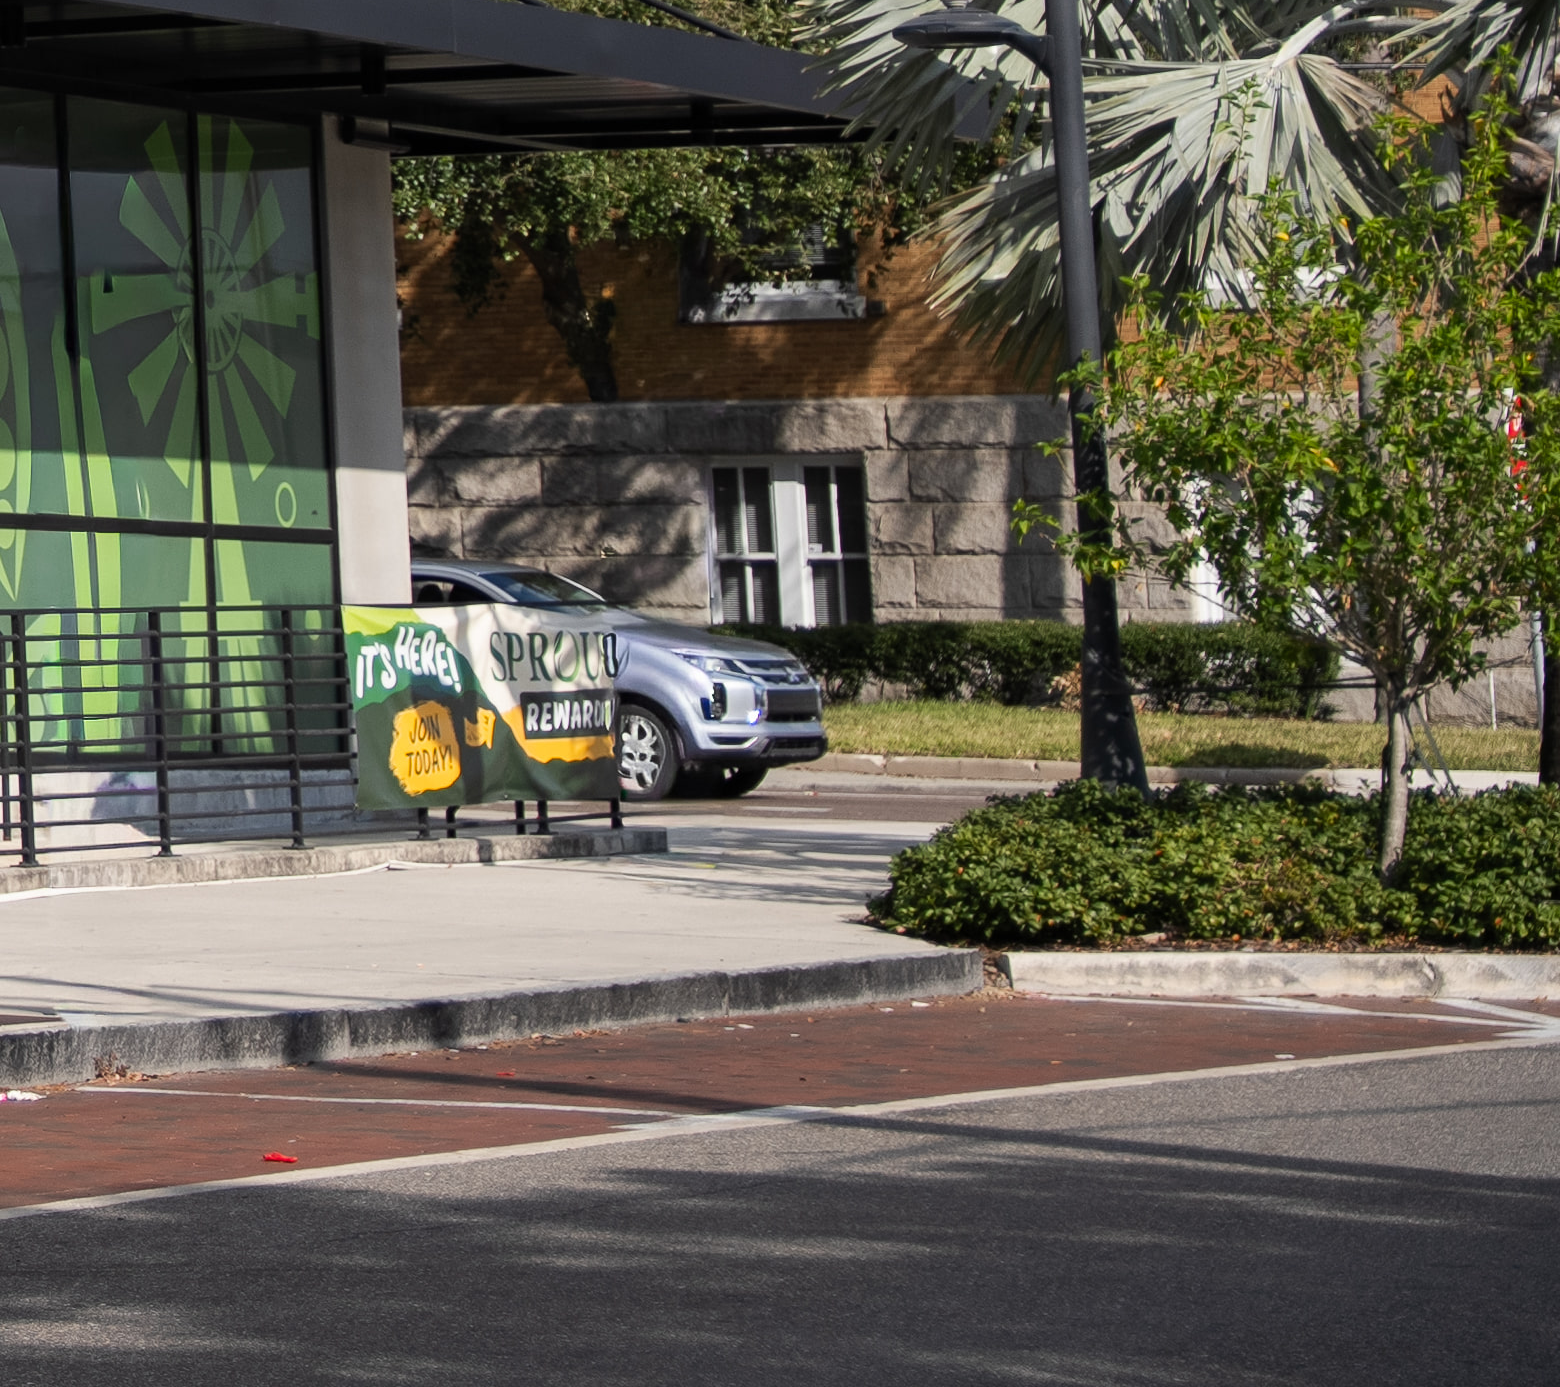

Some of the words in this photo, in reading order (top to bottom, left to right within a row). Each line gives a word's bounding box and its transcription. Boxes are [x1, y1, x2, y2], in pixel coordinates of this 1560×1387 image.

[356, 642, 397, 699] IT'S
[394, 625, 462, 694] HERE!
[490, 629, 604, 684] SPROU
[408, 712, 440, 744] JOIN
[405, 744, 454, 777] TODAY!
